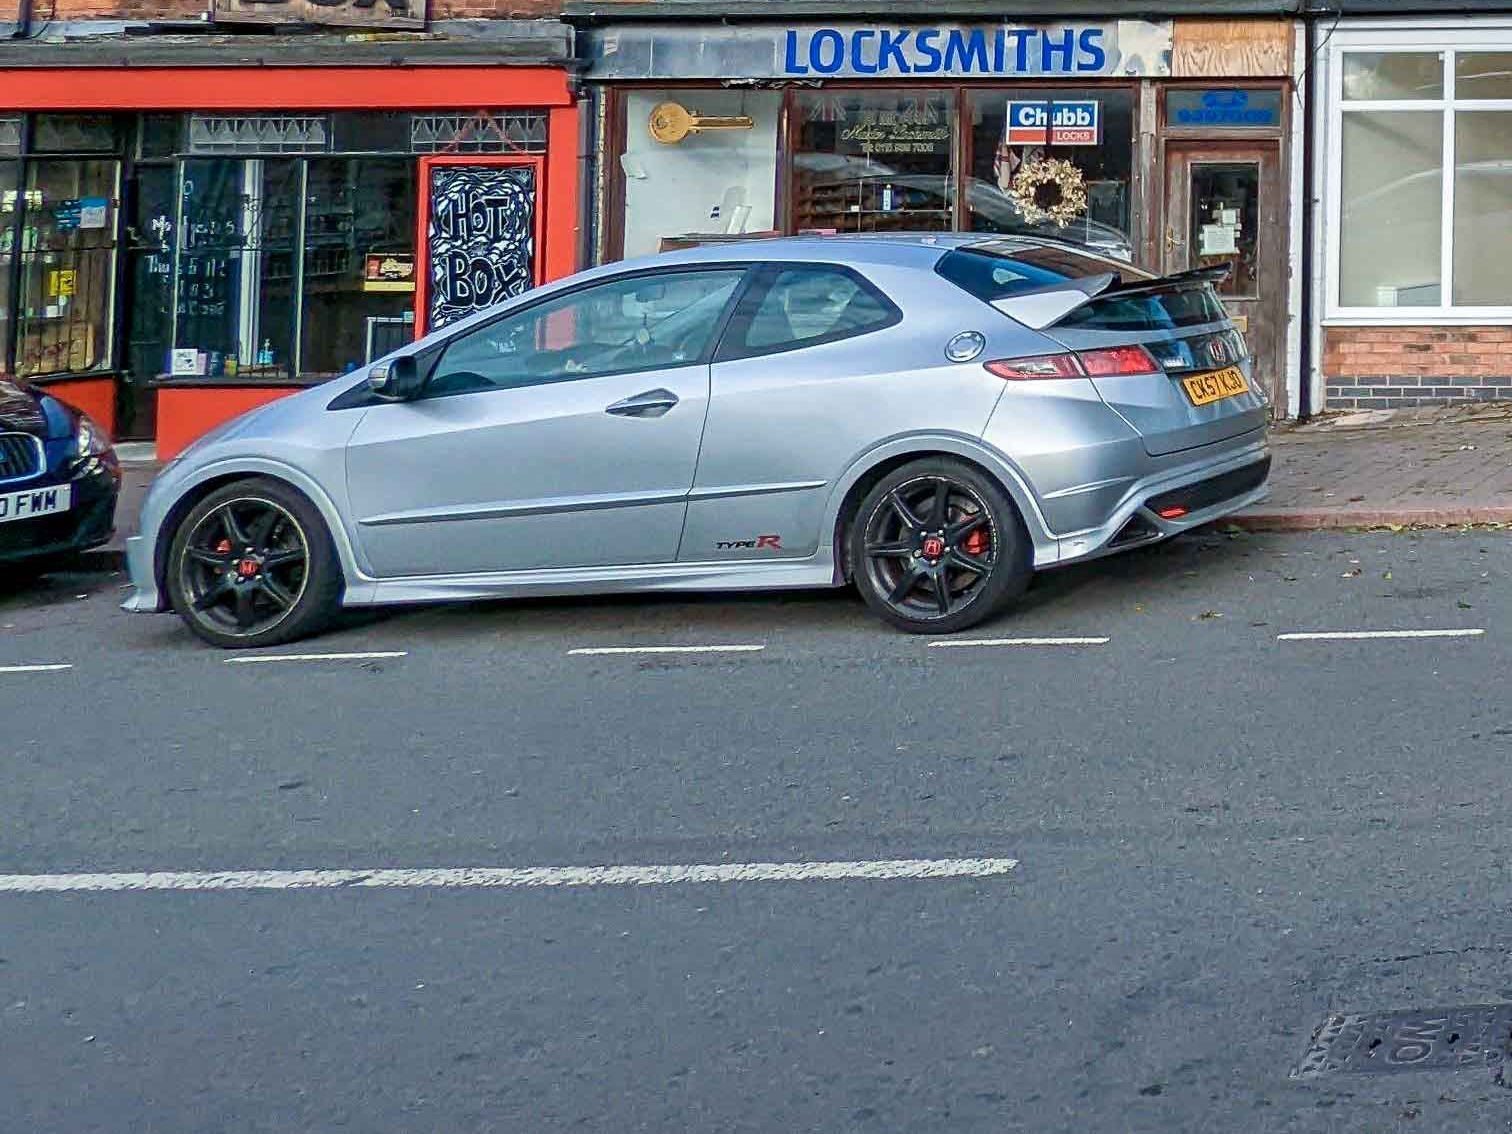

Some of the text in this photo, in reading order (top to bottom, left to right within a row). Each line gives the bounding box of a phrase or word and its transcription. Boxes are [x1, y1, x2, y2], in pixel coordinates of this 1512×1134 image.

[784, 28, 1106, 74] LOCKSMITHS
[1018, 106, 1091, 126] Chubb
[1057, 131, 1090, 140] LOCKS
[444, 190, 511, 242] HOT
[441, 249, 525, 309] BOX
[716, 535, 783, 549] TYPE R
